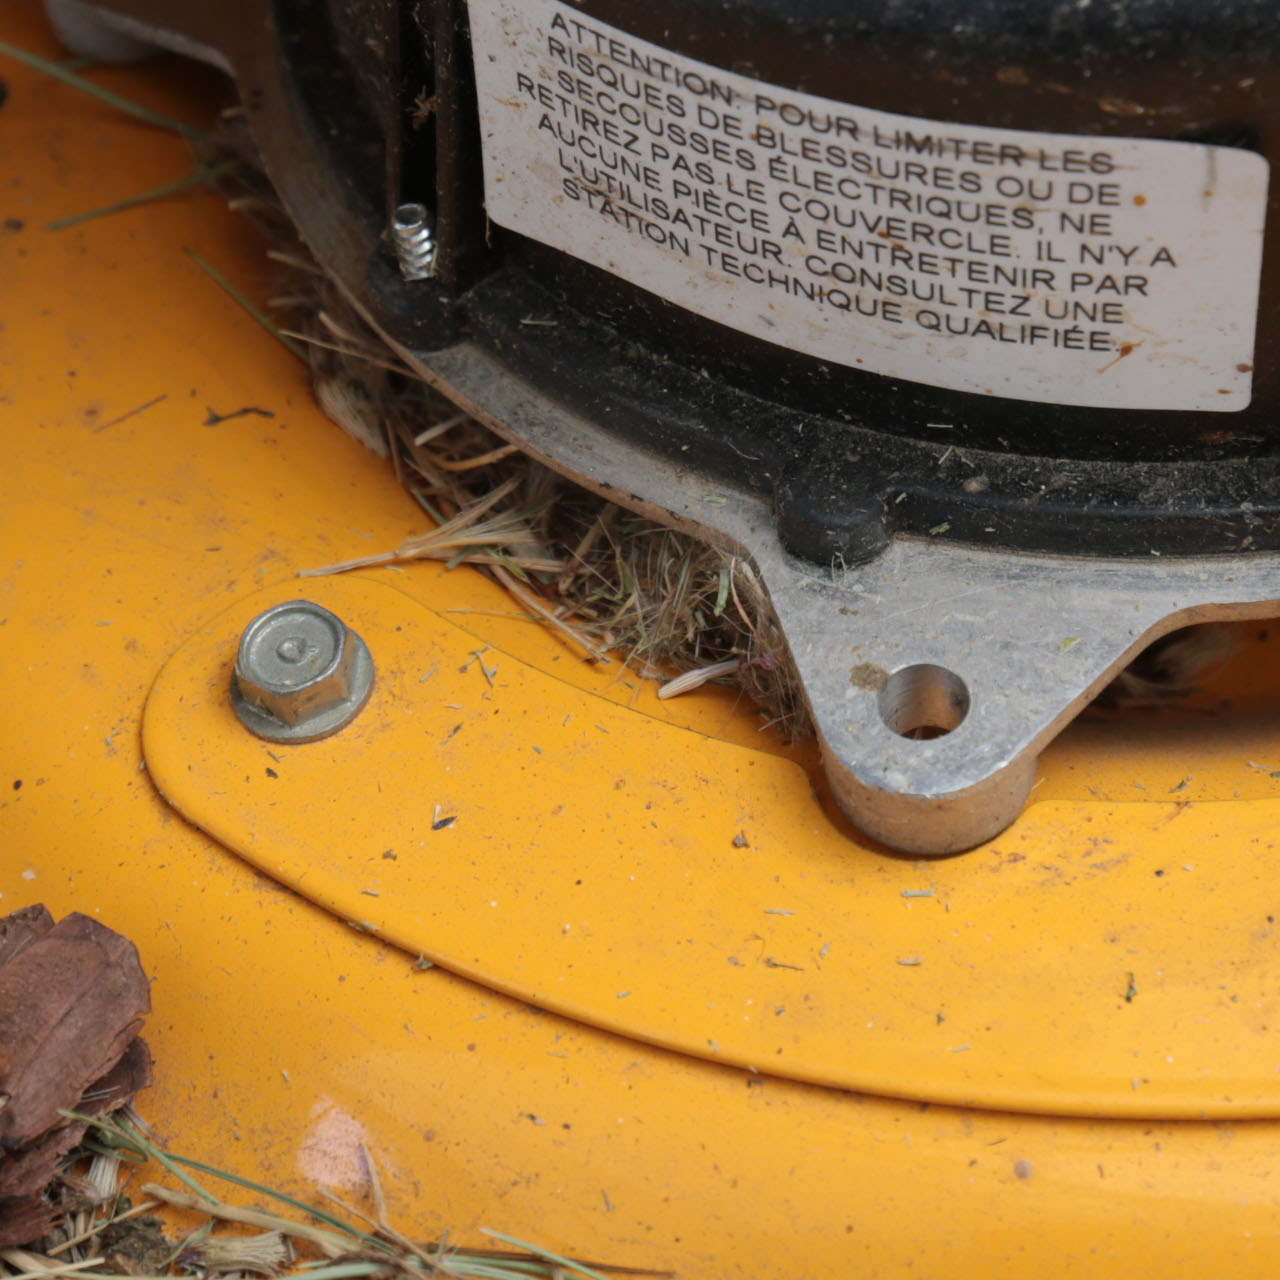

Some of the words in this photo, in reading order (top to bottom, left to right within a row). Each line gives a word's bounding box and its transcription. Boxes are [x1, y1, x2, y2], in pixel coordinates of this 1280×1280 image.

[517, 71, 642, 156] RETIREZ
[651, 142, 715, 185] PAS
[726, 172, 768, 205] LE
[778, 191, 1020, 260] COUVERCLE.
[1036, 239, 1066, 263] IL
[1080, 242, 1139, 266] N'Y
[1149, 246, 1177, 268] A
[548, 35, 686, 117] RISQUES
[697, 105, 743, 140] DE
[756, 124, 982, 194] BLESSURES
[996, 175, 1053, 201] OU
[1067, 182, 1121, 207] DE
[551, 12, 742, 109] ATTENTION:
[754, 93, 859, 141] POUR
[873, 125, 1024, 167] LIMITER
[1038, 148, 1116, 175] LES
[557, 69, 756, 171] SECOUSSES
[769, 155, 1043, 235] ÉLECTRIQUES,
[1060, 212, 1113, 236] NE
[538, 112, 663, 192] AUCUNE
[672, 178, 771, 234] PIÈCE
[781, 214, 807, 245] À
[816, 228, 1056, 291] ENTRETENIR
[1071, 272, 1149, 297] PAR
[558, 147, 793, 268] L'UTILISATEUR.
[805, 254, 1031, 318] CONSULTEZ
[1044, 299, 1125, 325] UNE
[563, 177, 690, 257] STATION
[699, 243, 903, 324] TECHNIQUE
[915, 310, 1121, 353] QUALIFIÉE.
